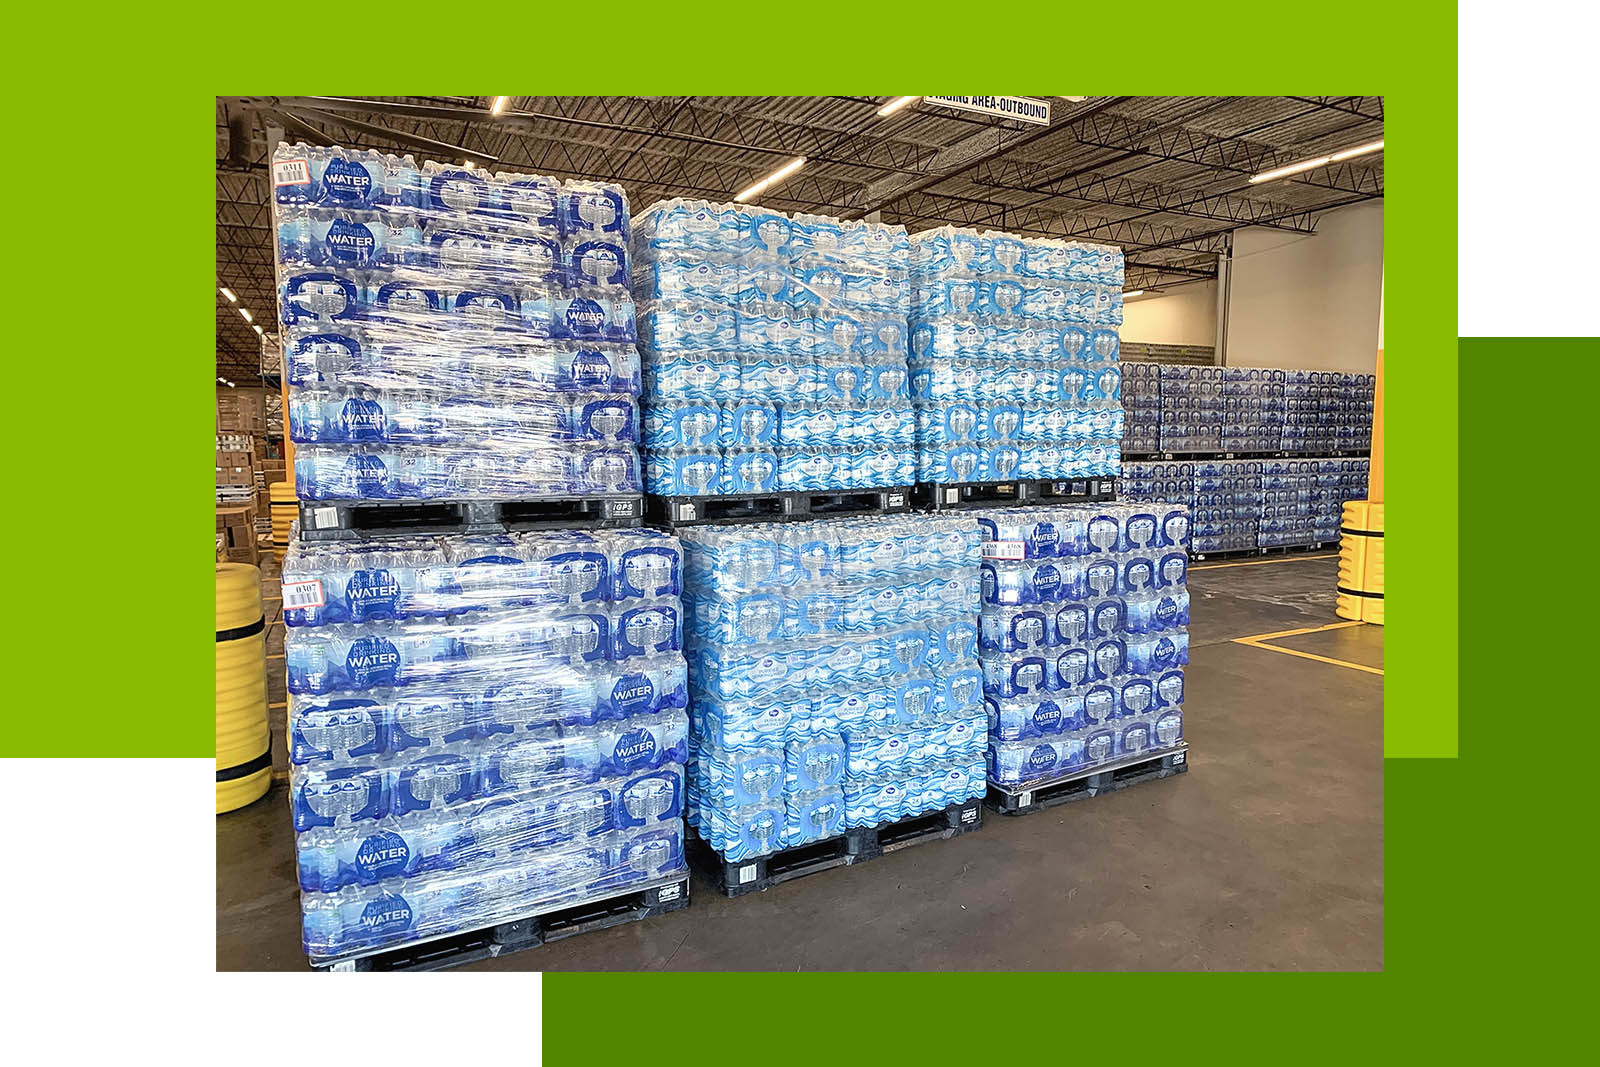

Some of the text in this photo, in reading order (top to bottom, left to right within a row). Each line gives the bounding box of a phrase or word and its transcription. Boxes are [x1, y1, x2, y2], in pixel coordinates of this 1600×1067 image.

[928, 96, 1047, 119] GING AREA-OUTBOUND
[325, 174, 370, 186] WATER
[328, 234, 373, 246] WATER
[567, 311, 604, 324] WATER
[573, 363, 610, 375] WATER
[342, 413, 385, 424] WATER
[1034, 575, 1060, 585] WATER
[295, 583, 317, 593] 0307
[347, 586, 398, 600] WATER
[348, 652, 398, 668] WATER
[613, 685, 652, 701] WATER
[1034, 711, 1061, 722] WATER
[615, 740, 654, 758] WATER
[1030, 753, 1056, 765] WATER
[358, 847, 407, 865] WATER
[362, 909, 410, 926] WATER
